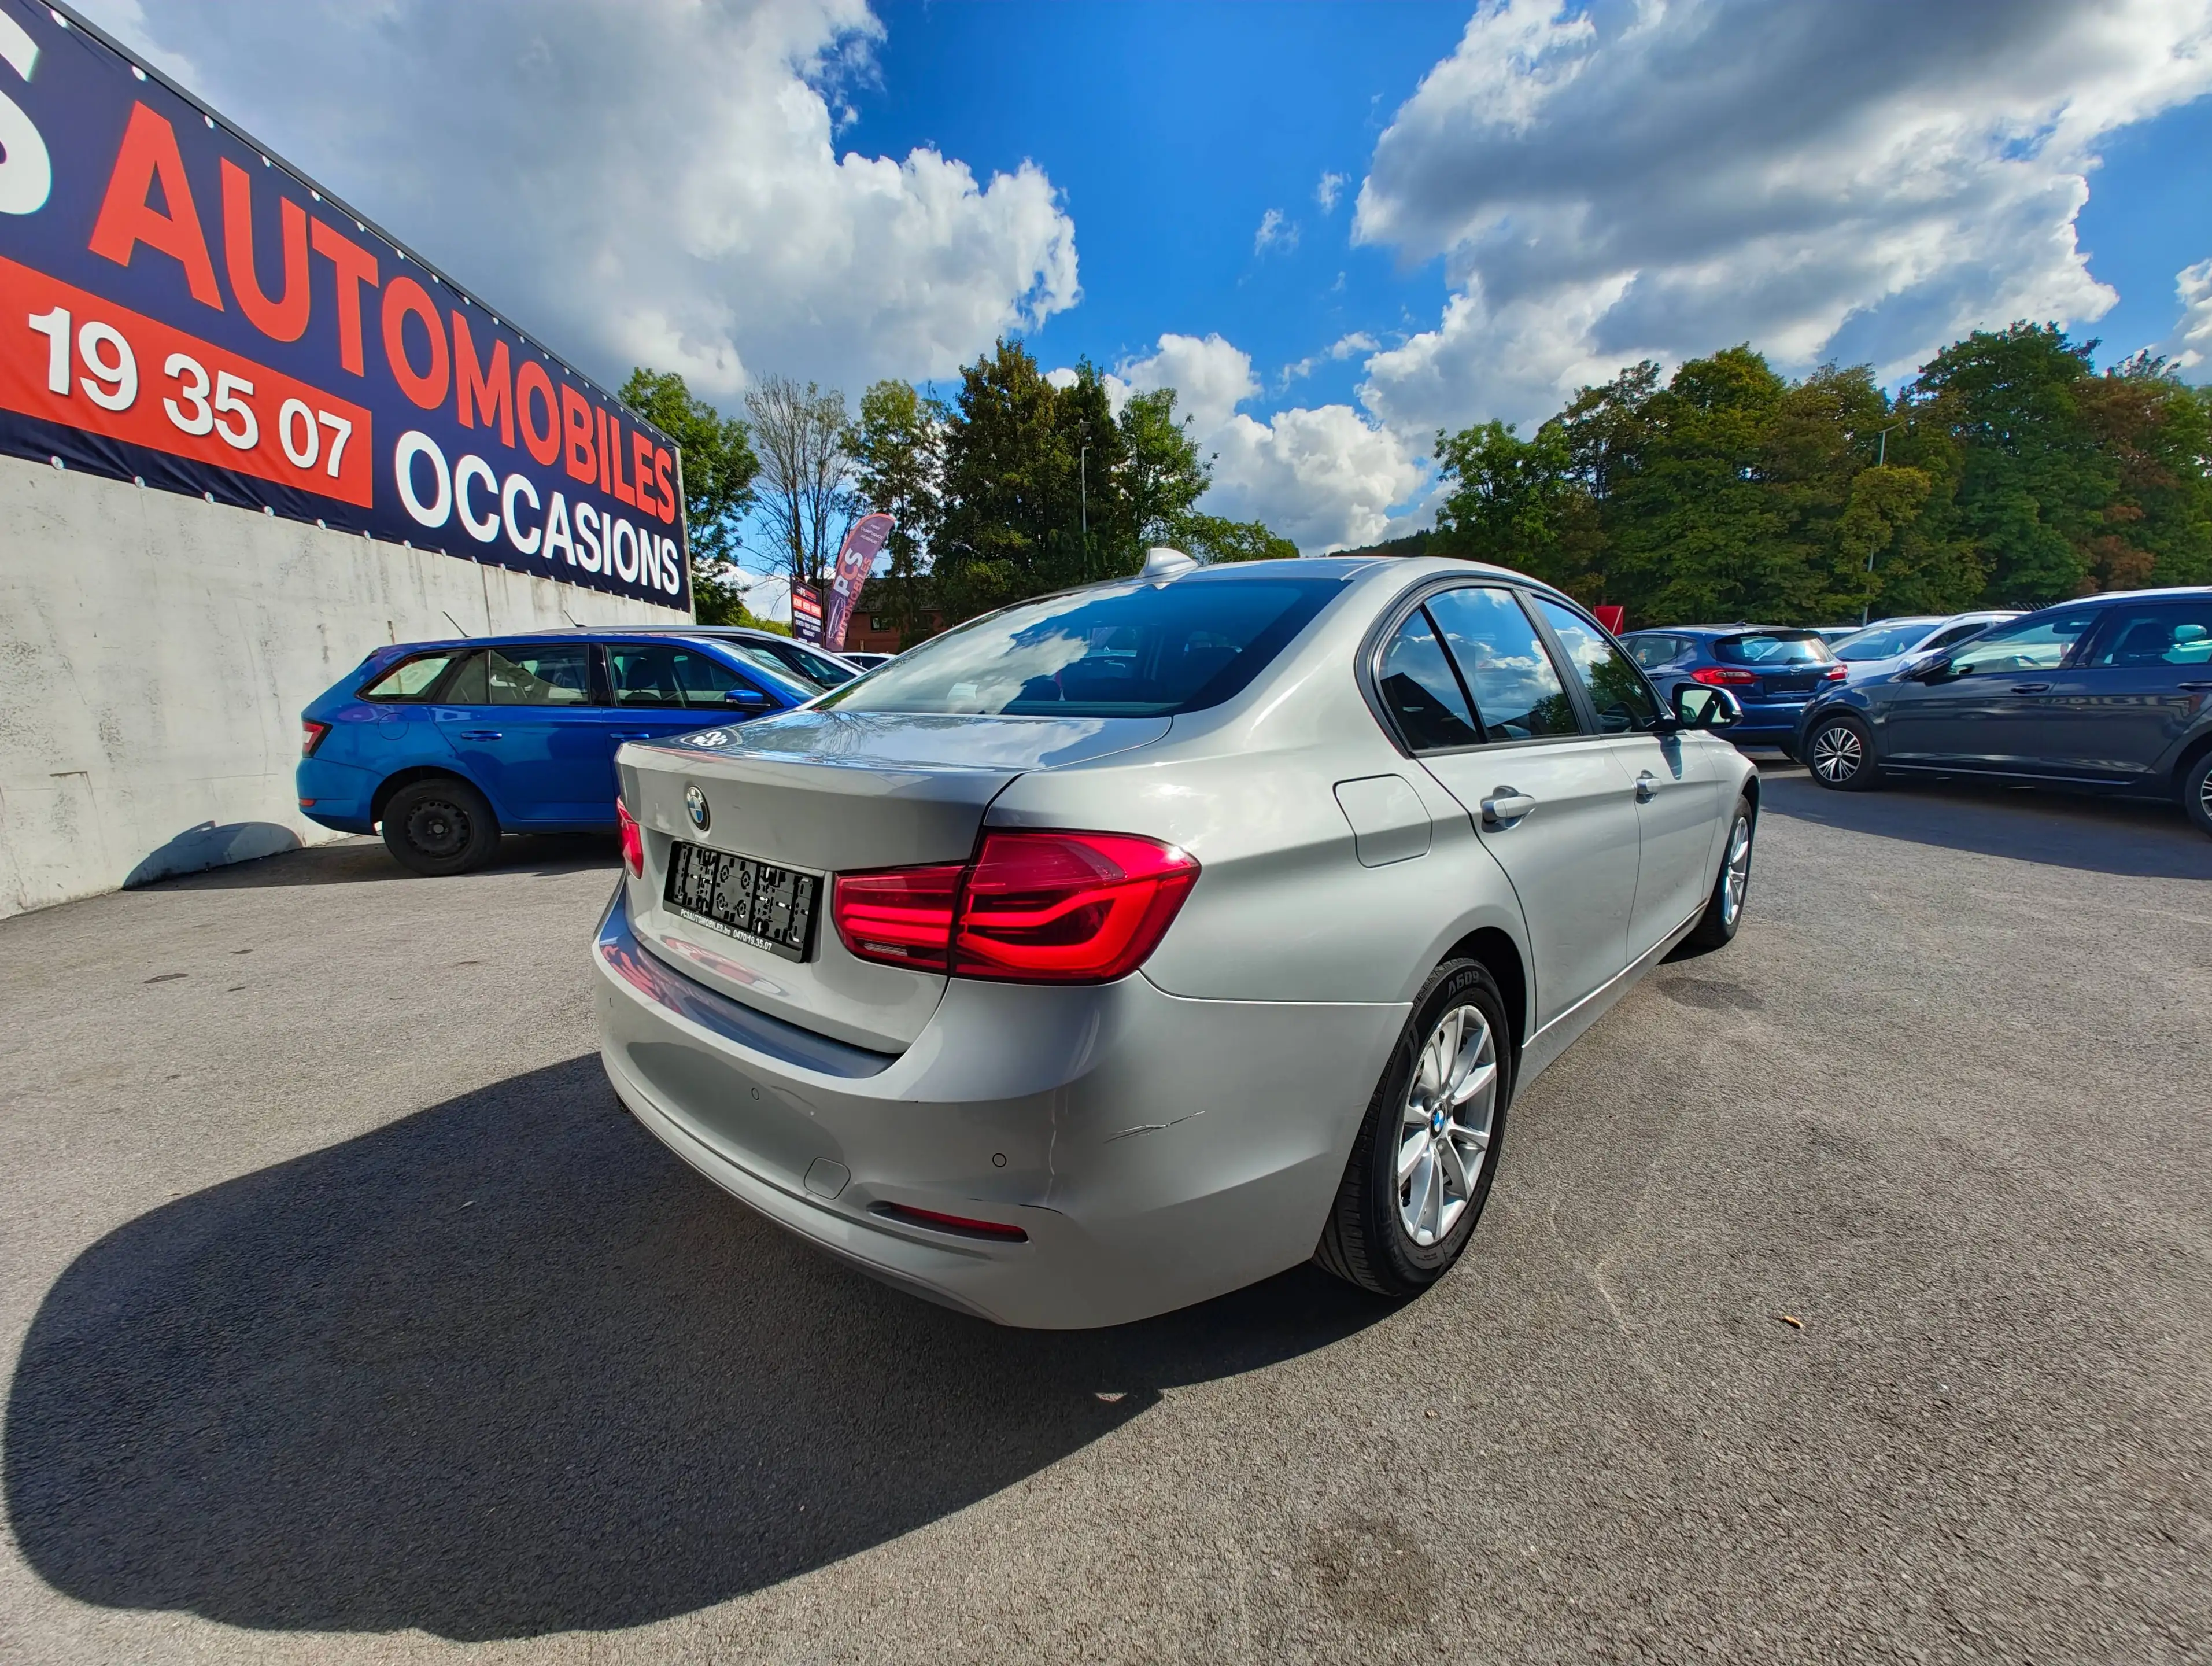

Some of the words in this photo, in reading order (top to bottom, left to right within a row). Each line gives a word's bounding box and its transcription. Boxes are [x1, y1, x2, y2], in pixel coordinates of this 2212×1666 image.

[88, 100, 675, 524] AUTOMOBILES
[28, 306, 139, 411] 19
[163, 353, 259, 450] 35
[279, 398, 353, 477] 07
[396, 430, 680, 595] OCCASIONS
[833, 548, 863, 597] PCS
[834, 557, 872, 647] AUTOMOBILES
[680, 909, 731, 935] PCSAUTOMOBILES.be
[733, 930, 773, 951] 0470/19.35.07
[1447, 971, 1479, 1000] A609
